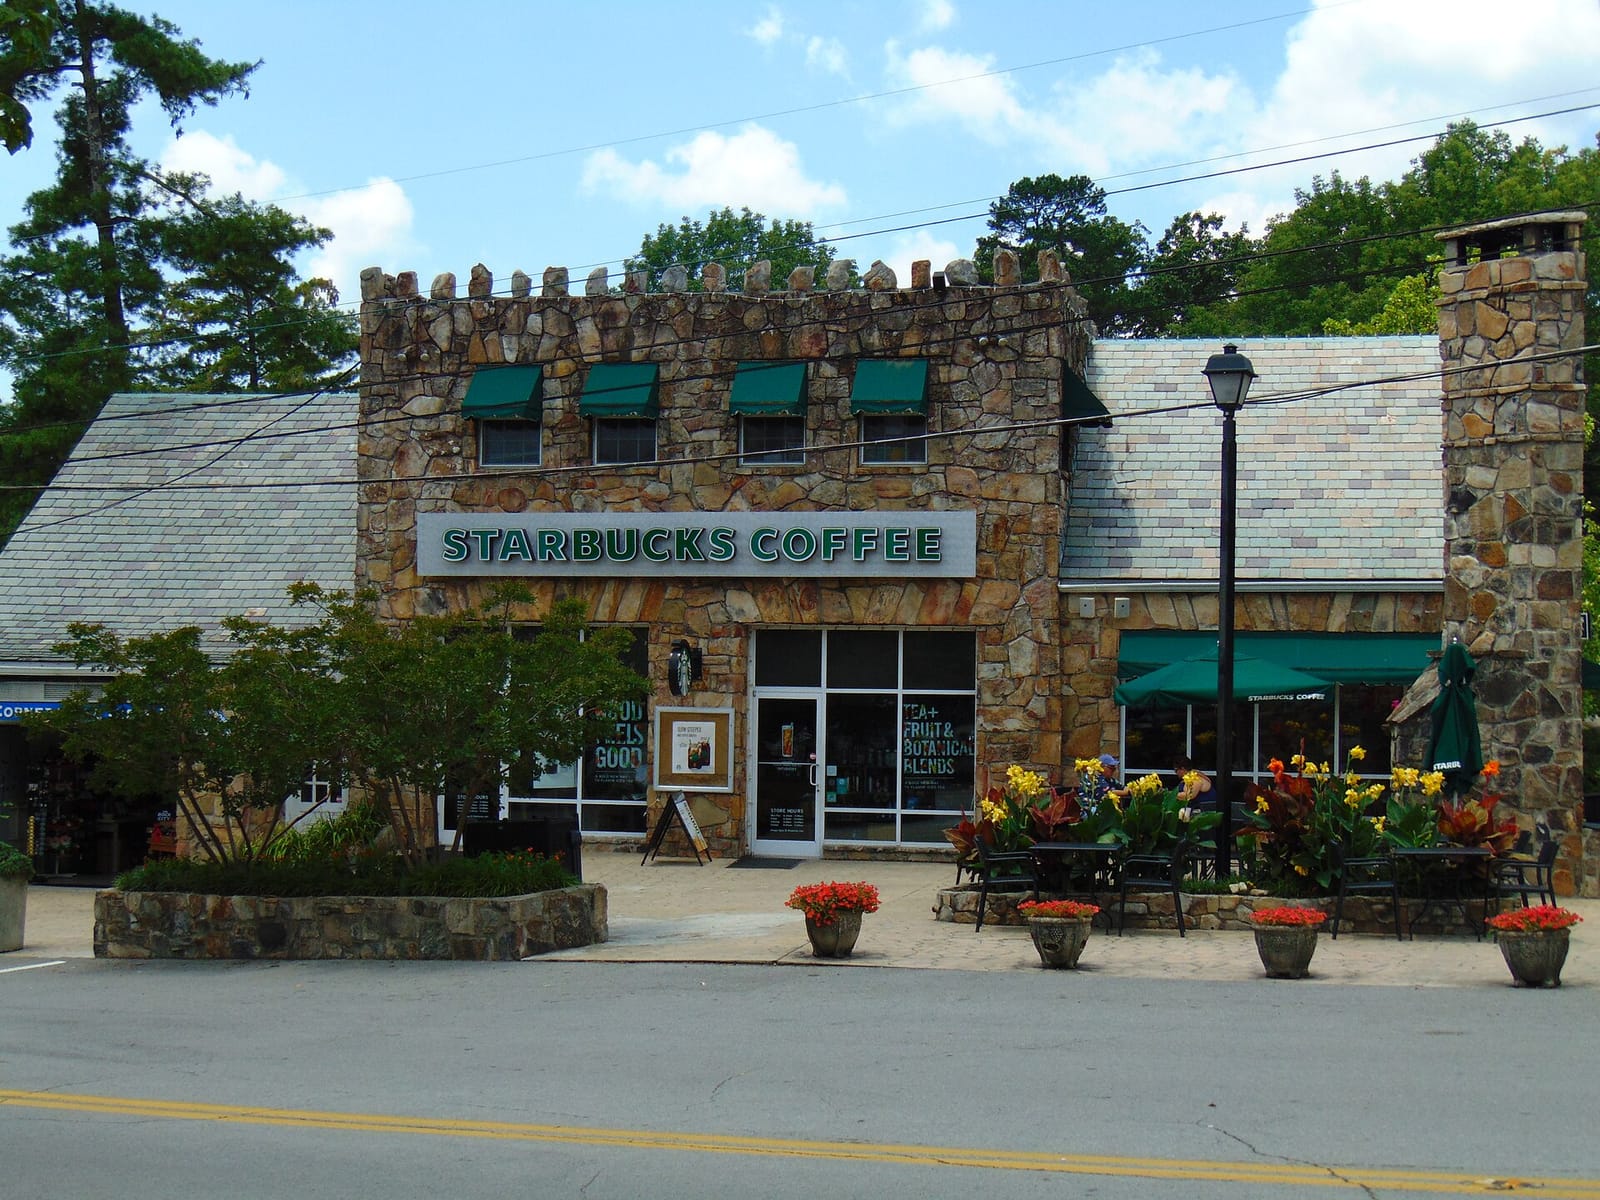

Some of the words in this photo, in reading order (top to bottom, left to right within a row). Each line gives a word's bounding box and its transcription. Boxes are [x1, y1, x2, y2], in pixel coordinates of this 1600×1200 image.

[441, 527, 736, 562] STARBUCKS
[749, 527, 942, 562] COFFEE
[904, 704, 938, 719] TEA+
[904, 722, 942, 737] FRUIT
[944, 722, 953, 737] &
[596, 746, 642, 768] GOOD
[904, 758, 954, 774] BLENDS
